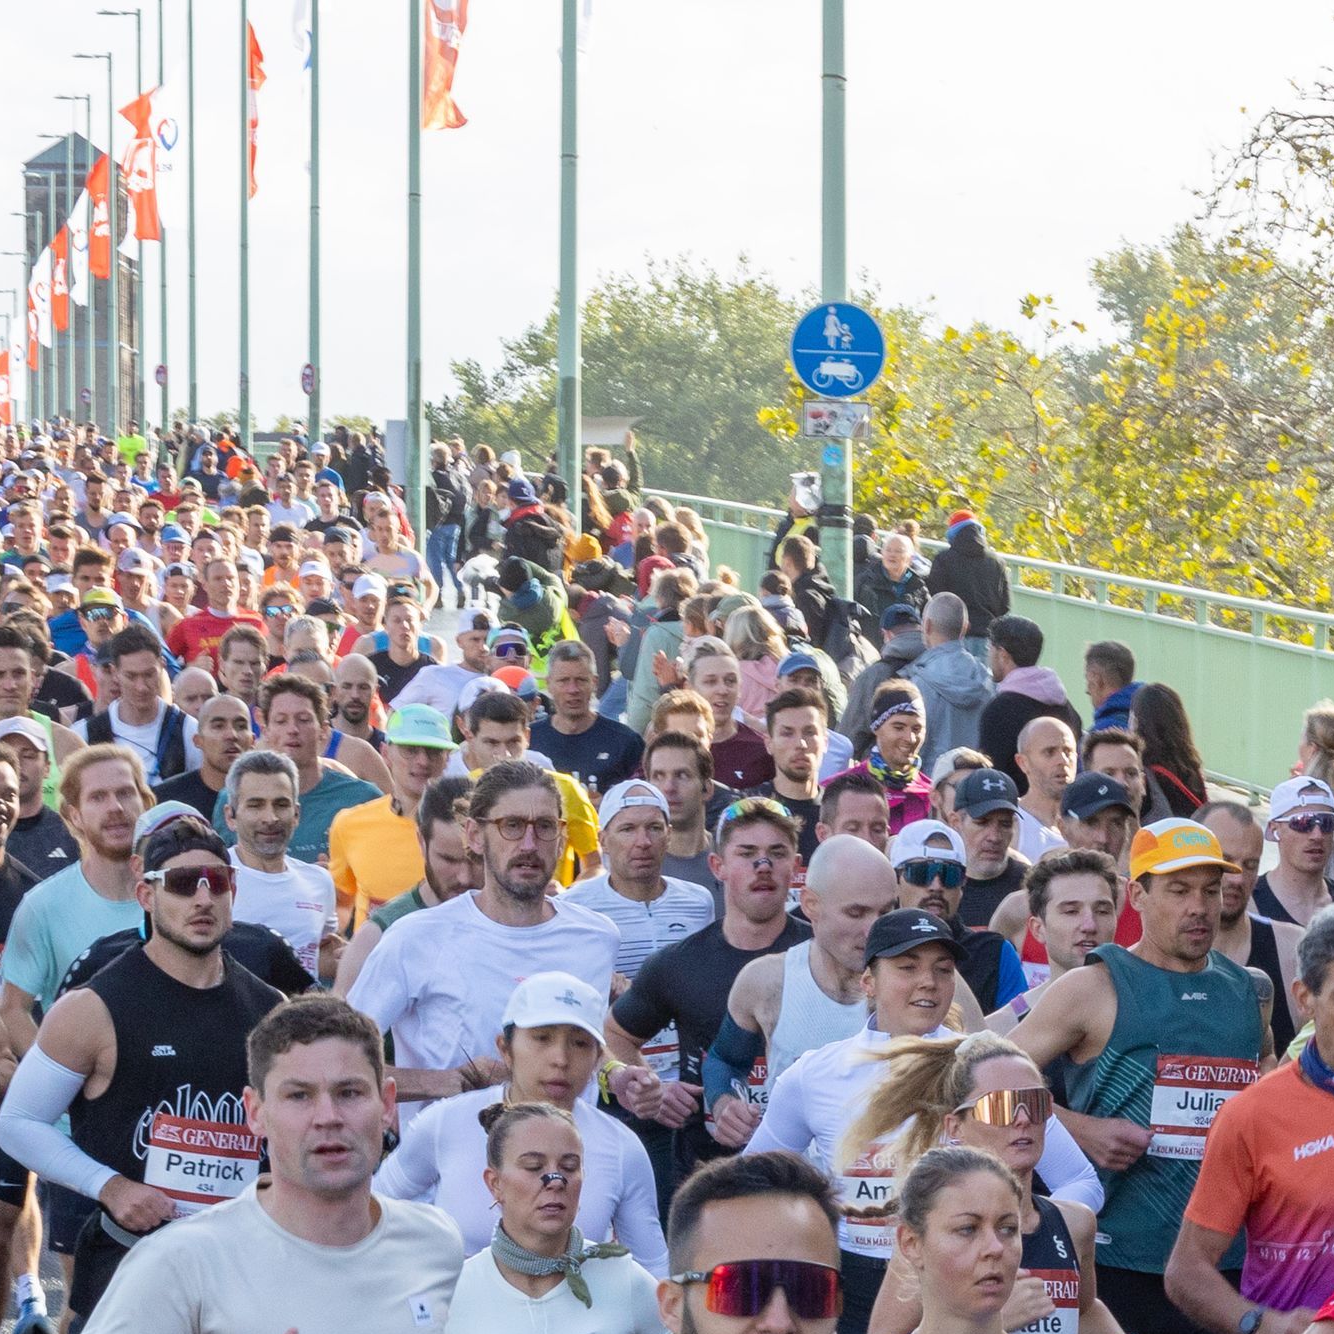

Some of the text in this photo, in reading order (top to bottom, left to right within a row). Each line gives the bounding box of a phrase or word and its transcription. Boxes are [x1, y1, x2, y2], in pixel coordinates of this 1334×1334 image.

[182, 1128, 260, 1153] GENERALI
[1175, 1145, 1204, 1156] MARATHO
[165, 1153, 245, 1181] Patrick
[196, 1183, 215, 1192] 434
